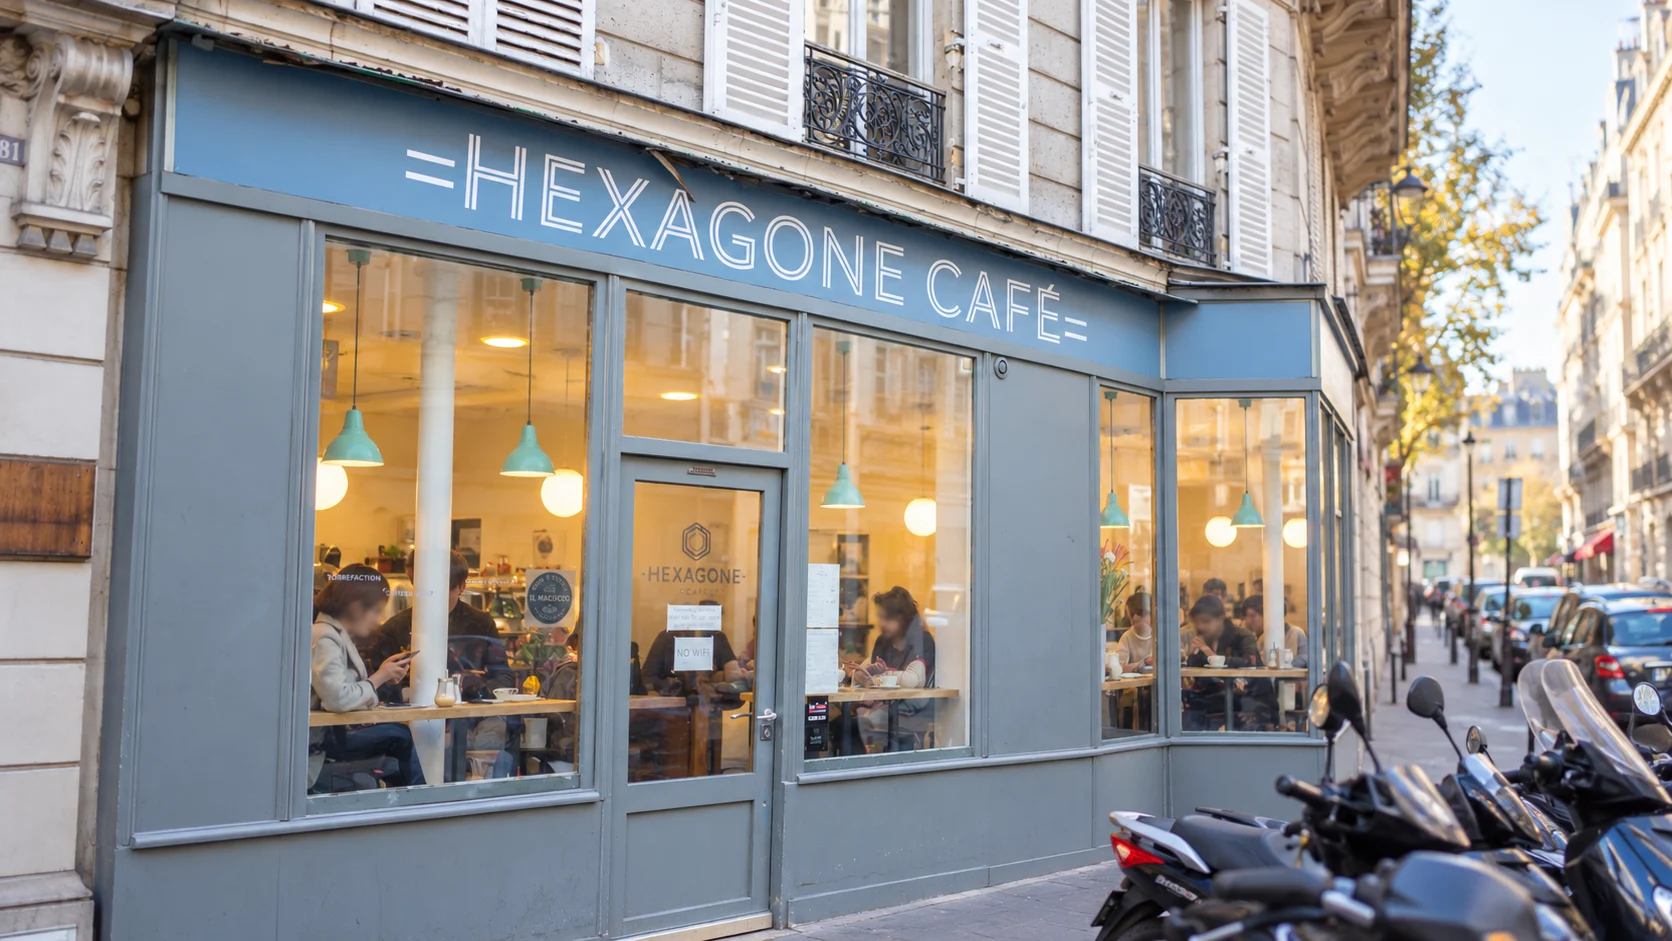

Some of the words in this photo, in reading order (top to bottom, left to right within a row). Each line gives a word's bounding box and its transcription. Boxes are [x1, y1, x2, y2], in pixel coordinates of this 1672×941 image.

[464, 133, 904, 306] HEXAGONE
[926, 259, 1061, 344] CAFÉ
[648, 566, 741, 584] HEXAGONE
[677, 648, 690, 657] NO
